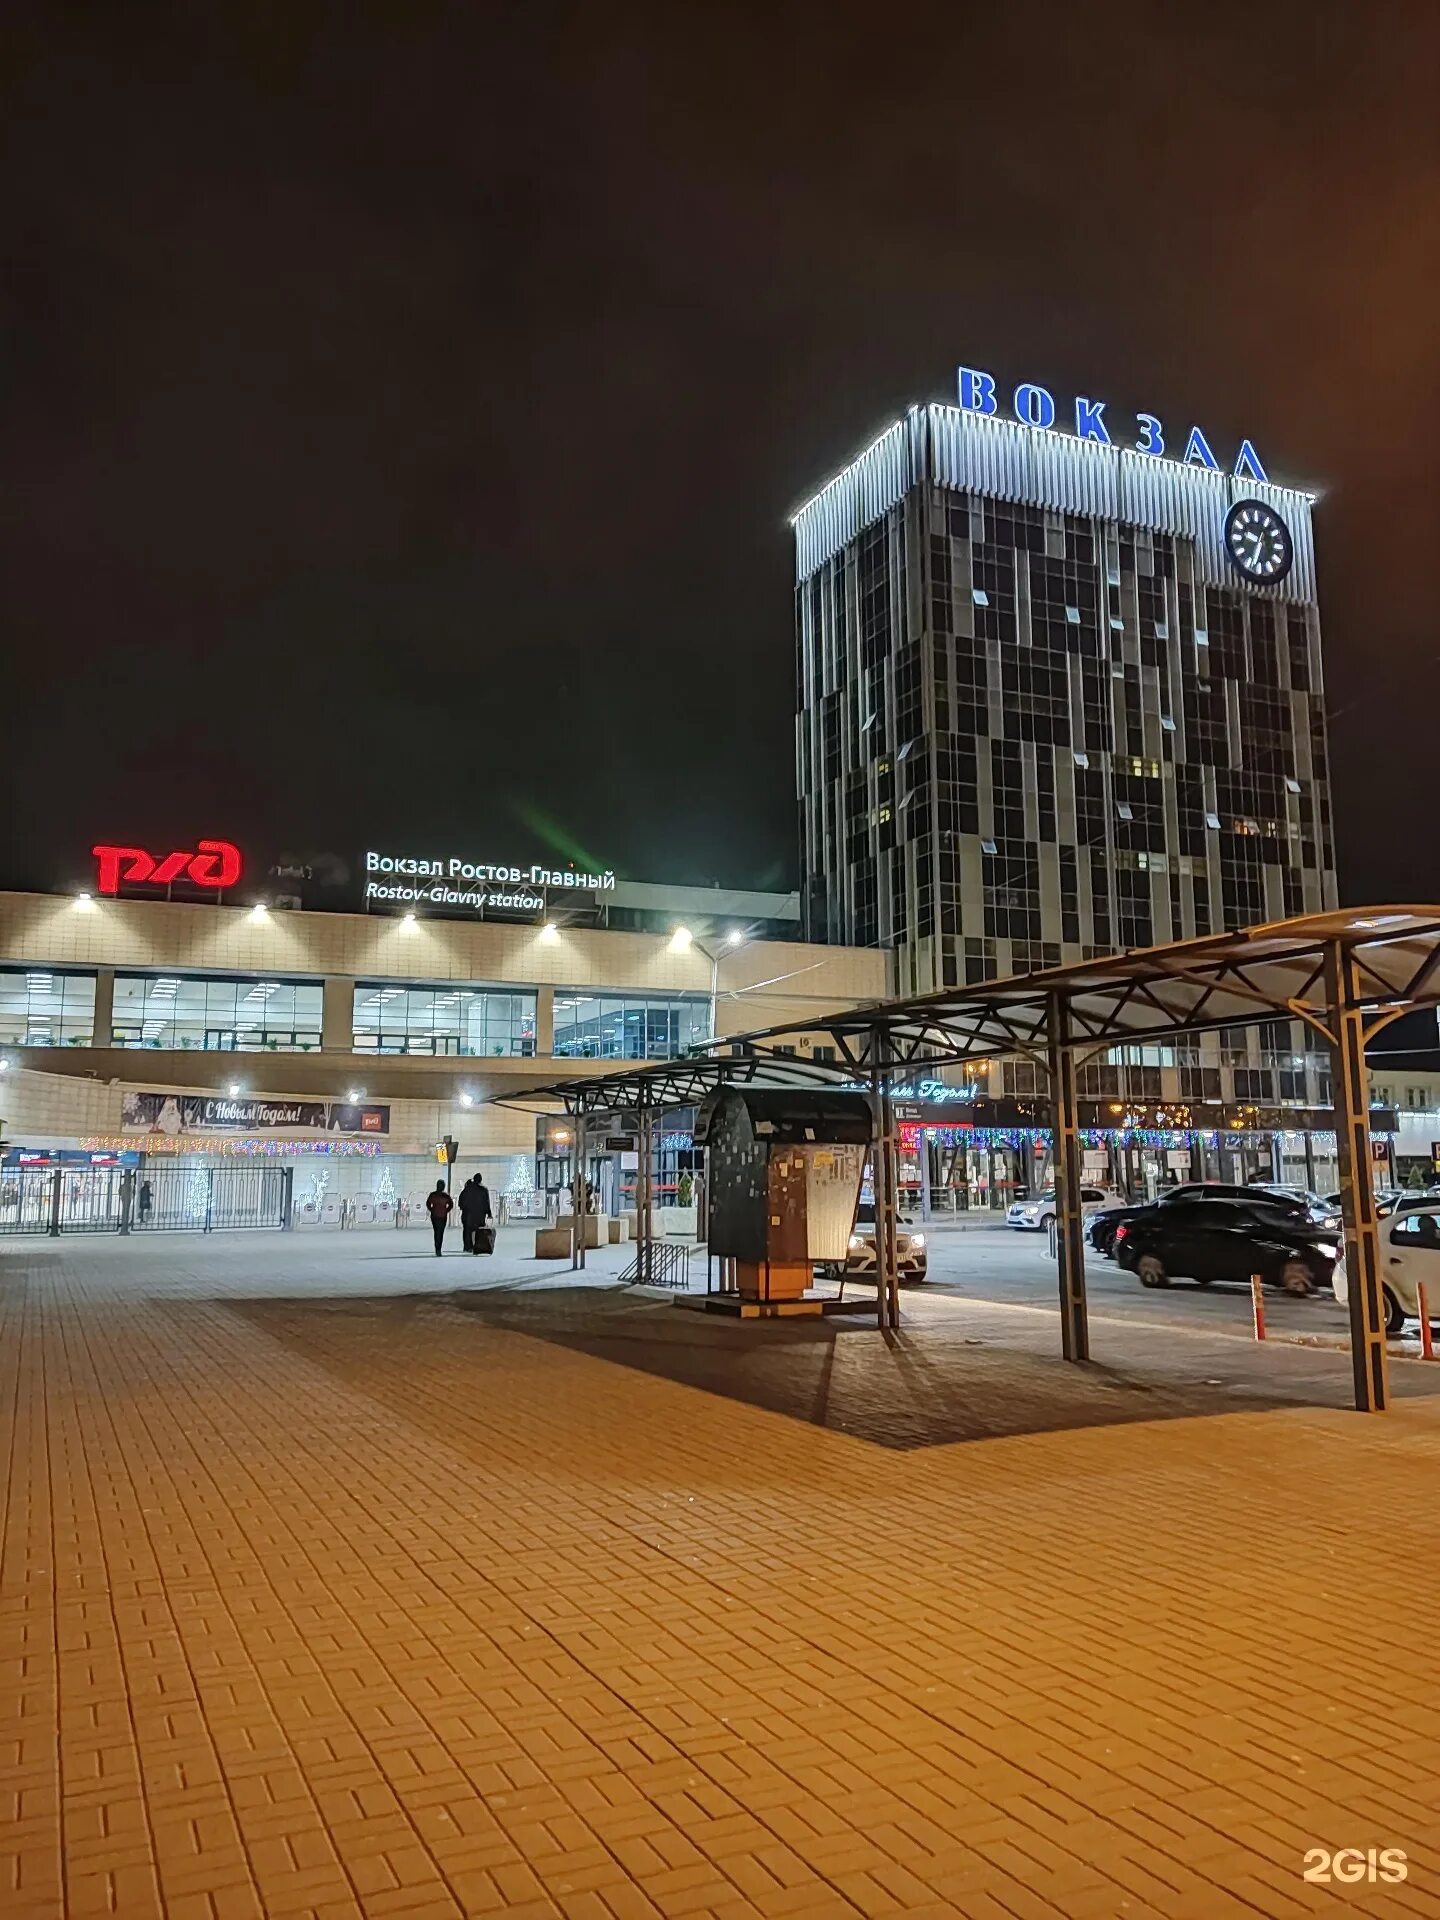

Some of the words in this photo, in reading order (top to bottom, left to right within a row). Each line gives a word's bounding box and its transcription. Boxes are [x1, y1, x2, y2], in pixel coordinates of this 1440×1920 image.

[958, 366, 1268, 483] ВОКЗАЛ
[366, 851, 442, 876] Вокзал
[449, 858, 616, 890] Ростов-Главный
[366, 882, 486, 909] Rostov-Glavny
[488, 892, 544, 910] station
[205, 1101, 215, 1119] С
[216, 1103, 256, 1121] Новым
[256, 1104, 302, 1126] Годом!
[1375, 1142, 1385, 1159] P
